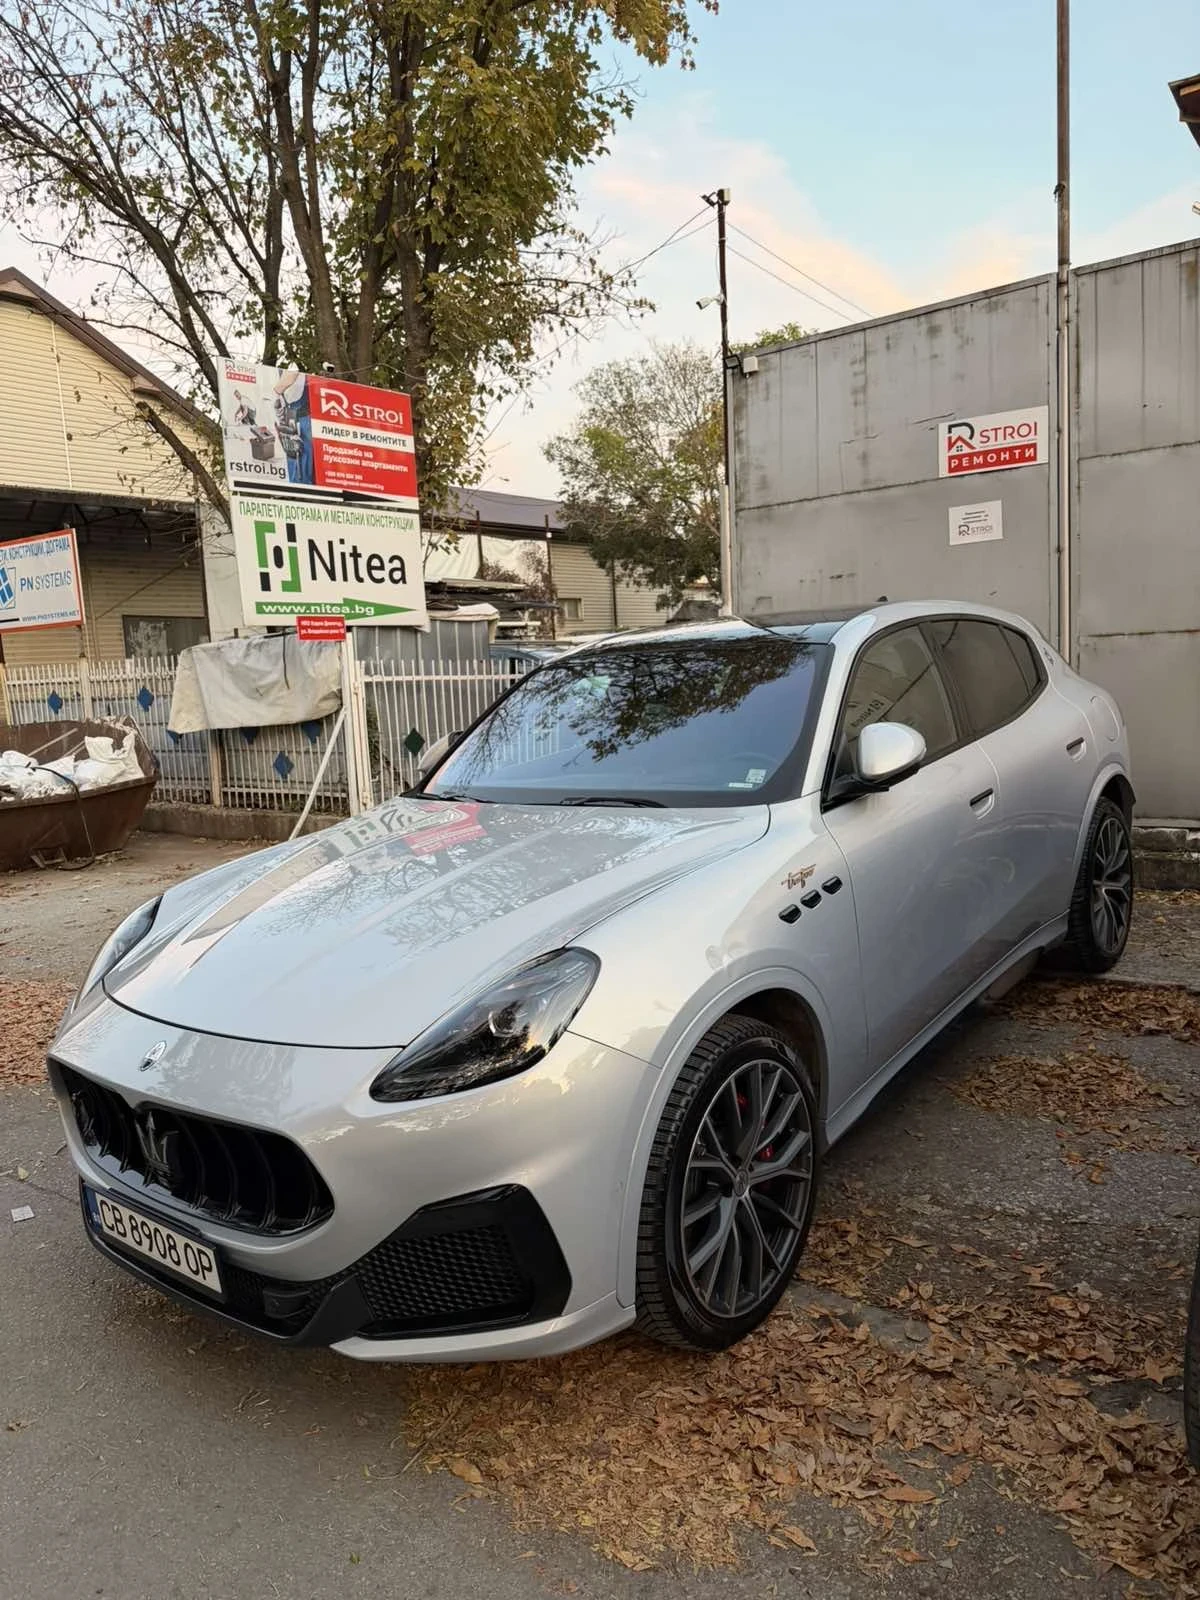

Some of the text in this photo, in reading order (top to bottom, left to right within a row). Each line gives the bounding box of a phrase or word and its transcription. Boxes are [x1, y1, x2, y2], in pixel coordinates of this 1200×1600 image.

[321, 426, 407, 447] ЛИДЕР В РЕМОНТИТЕ
[322, 444, 362, 457] Продажба
[951, 447, 1034, 468] РЕМОНТИ
[230, 460, 286, 480] rstroi.bg
[239, 500, 415, 532] ПАРАПЕТИ ДОГРАМА И МЕТАЛНИ КОНСТРУКЦИИ
[308, 538, 407, 585] Nitea
[20, 570, 72, 592] PN SYSTEMS
[263, 603, 375, 616] www.nitea.bg
[99, 1199, 127, 1238] CB
[129, 1214, 180, 1267] 8908
